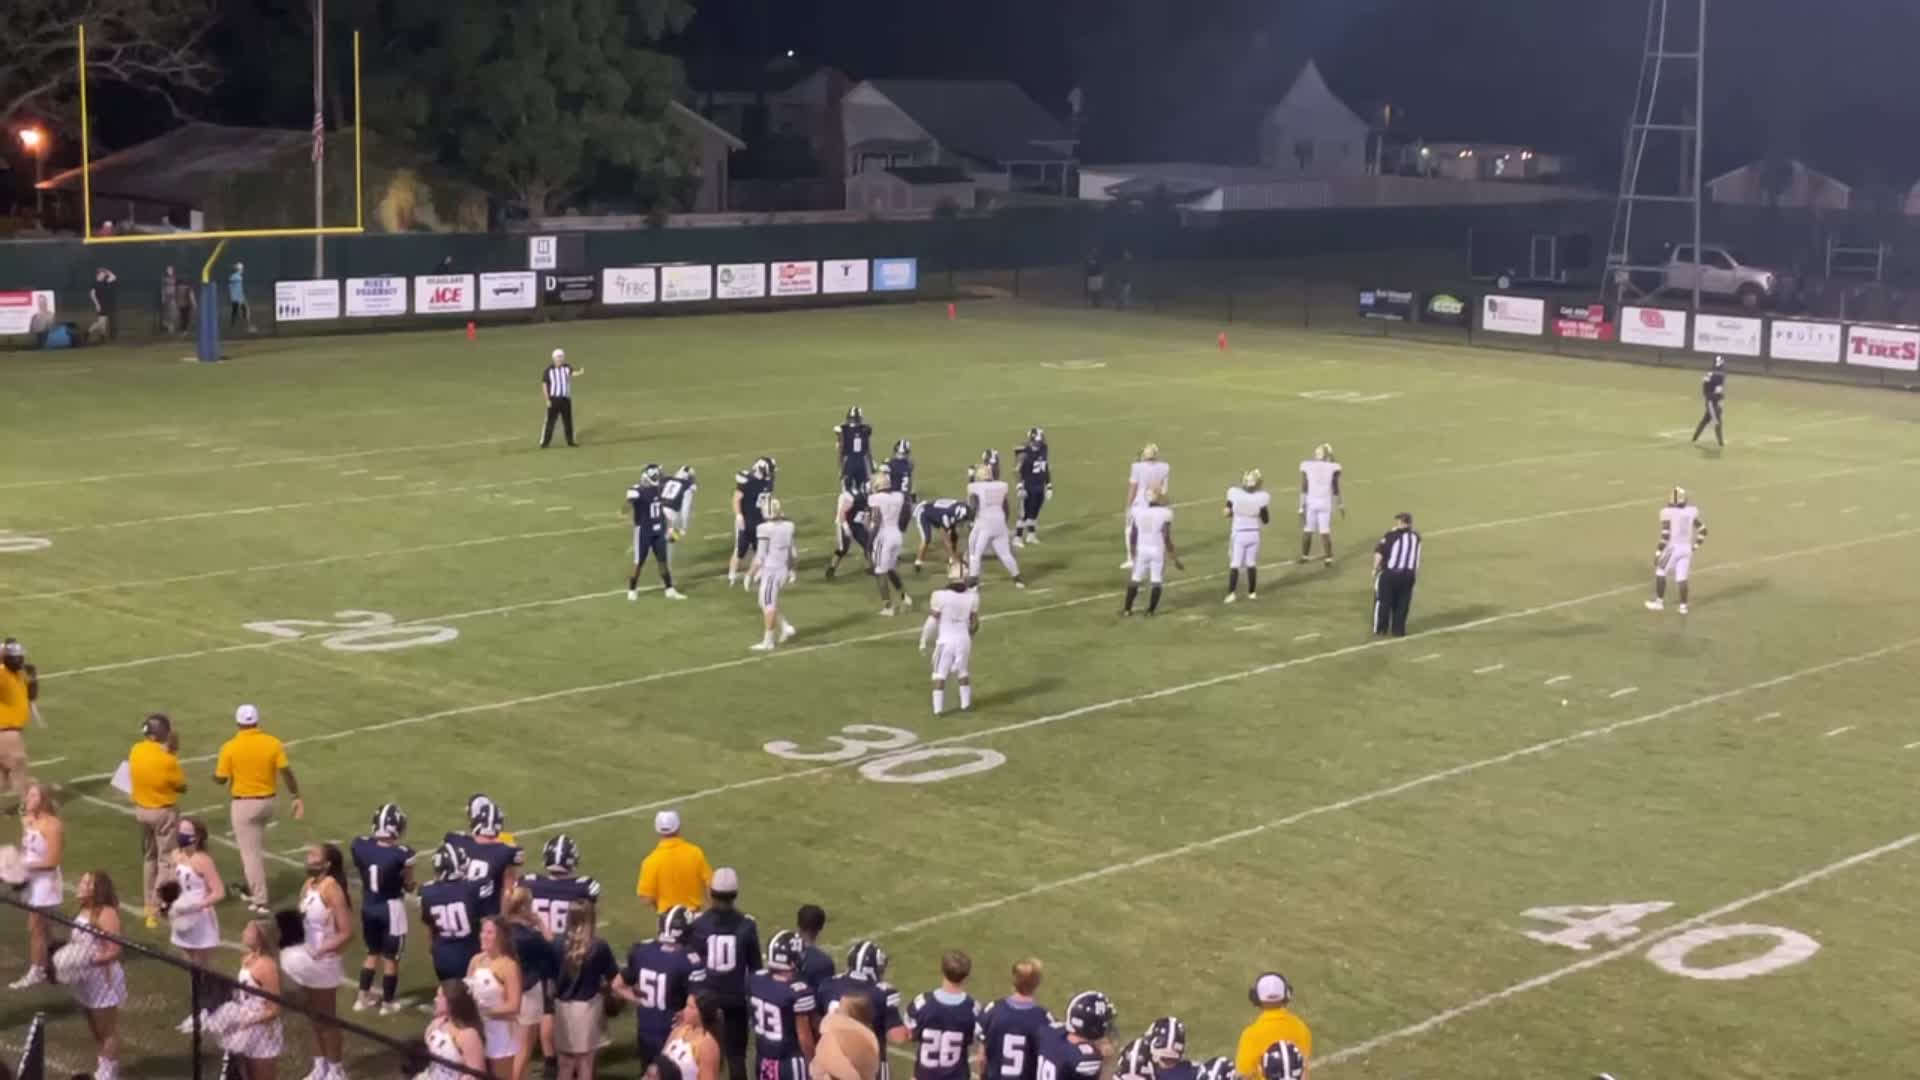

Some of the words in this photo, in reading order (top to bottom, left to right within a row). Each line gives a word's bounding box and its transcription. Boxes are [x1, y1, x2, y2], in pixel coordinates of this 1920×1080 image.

[430, 287, 462, 304] ACE
[1775, 330, 1836, 342] PRUITT
[242, 609, 460, 651] 20
[763, 724, 1006, 783] 30
[368, 864, 379, 893] 1
[430, 901, 471, 938] 30
[706, 933, 737, 972] 10
[1520, 901, 1822, 980] 40
[640, 967, 667, 1011] 51
[751, 996, 783, 1041] 33
[920, 1028, 964, 1068] 26
[1001, 1033, 1026, 1076] 5
